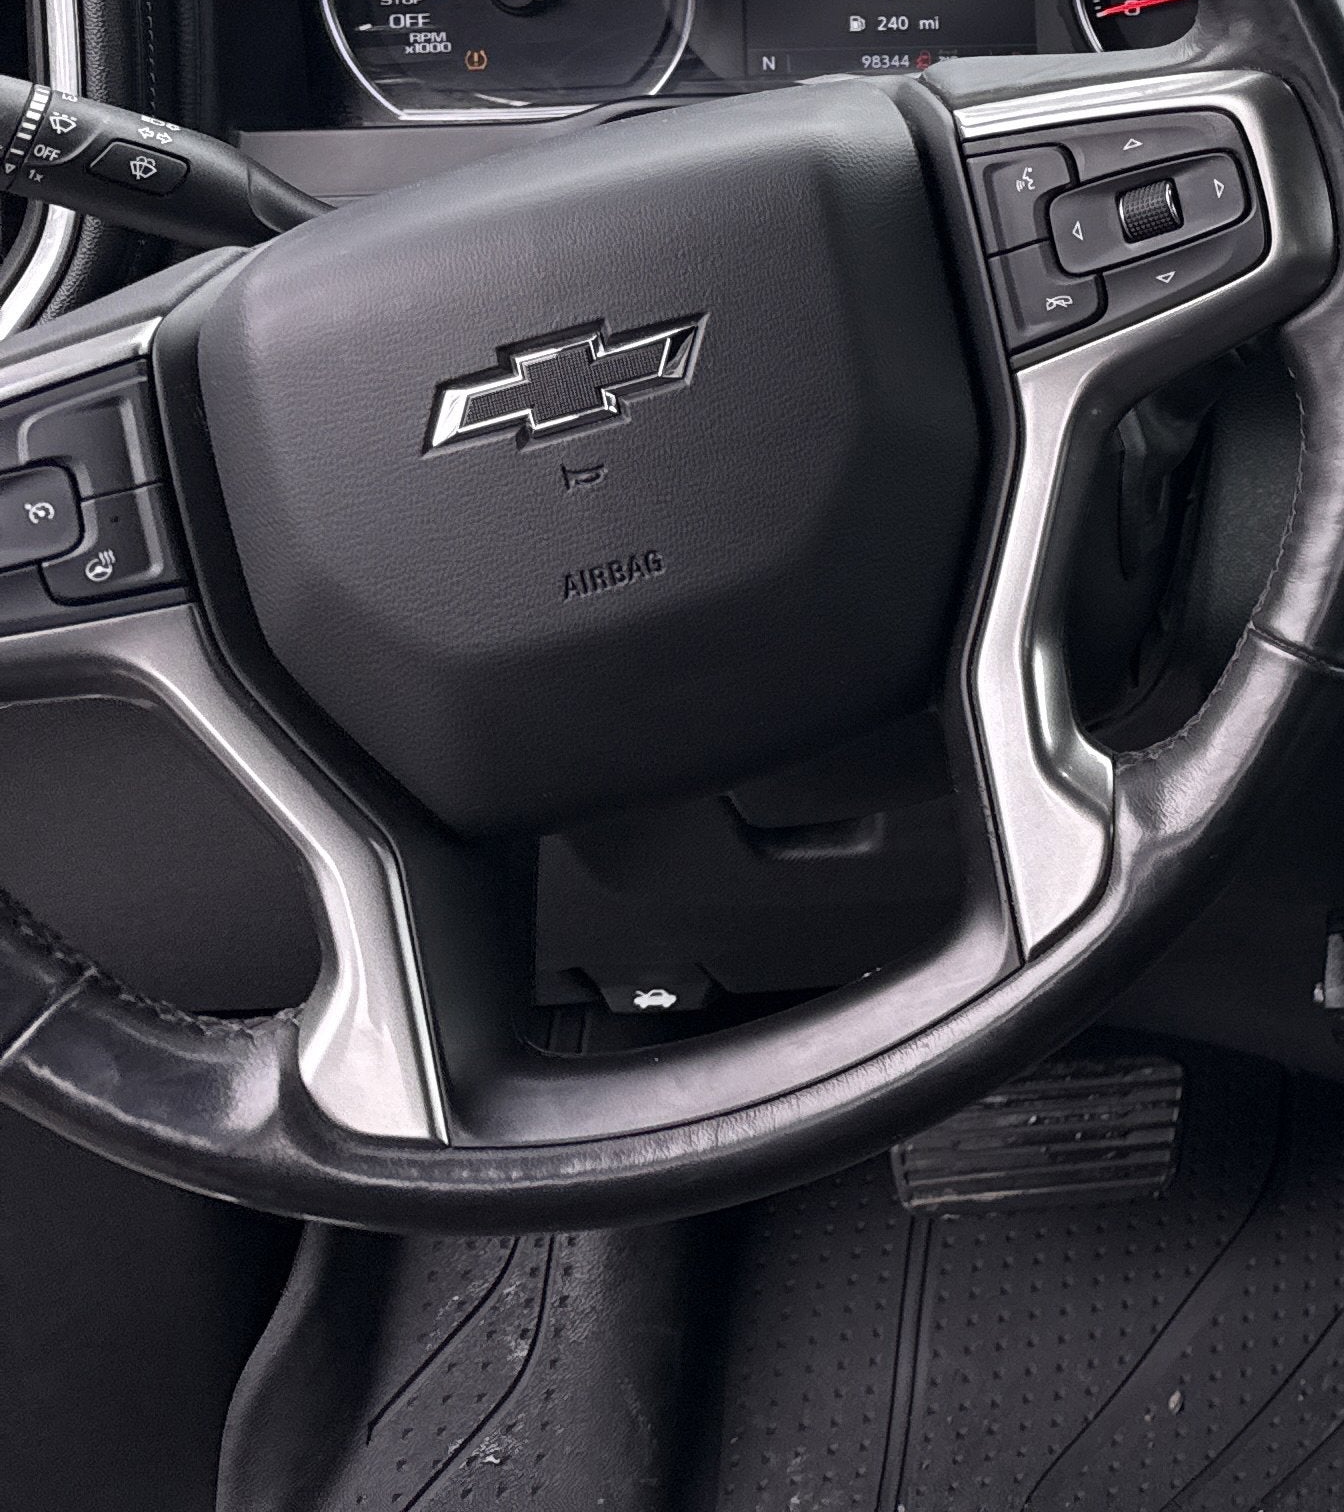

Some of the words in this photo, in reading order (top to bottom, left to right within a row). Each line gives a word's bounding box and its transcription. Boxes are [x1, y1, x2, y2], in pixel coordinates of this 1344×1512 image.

[388, 13, 431, 29] OFF
[877, 16, 909, 31] 240
[919, 16, 940, 30] mi
[409, 31, 447, 43] RPM
[404, 42, 452, 54] x1000
[762, 56, 776, 71] N
[861, 55, 910, 69] 98344
[33, 143, 61, 162] OFF
[563, 549, 665, 602] AIRBAG
